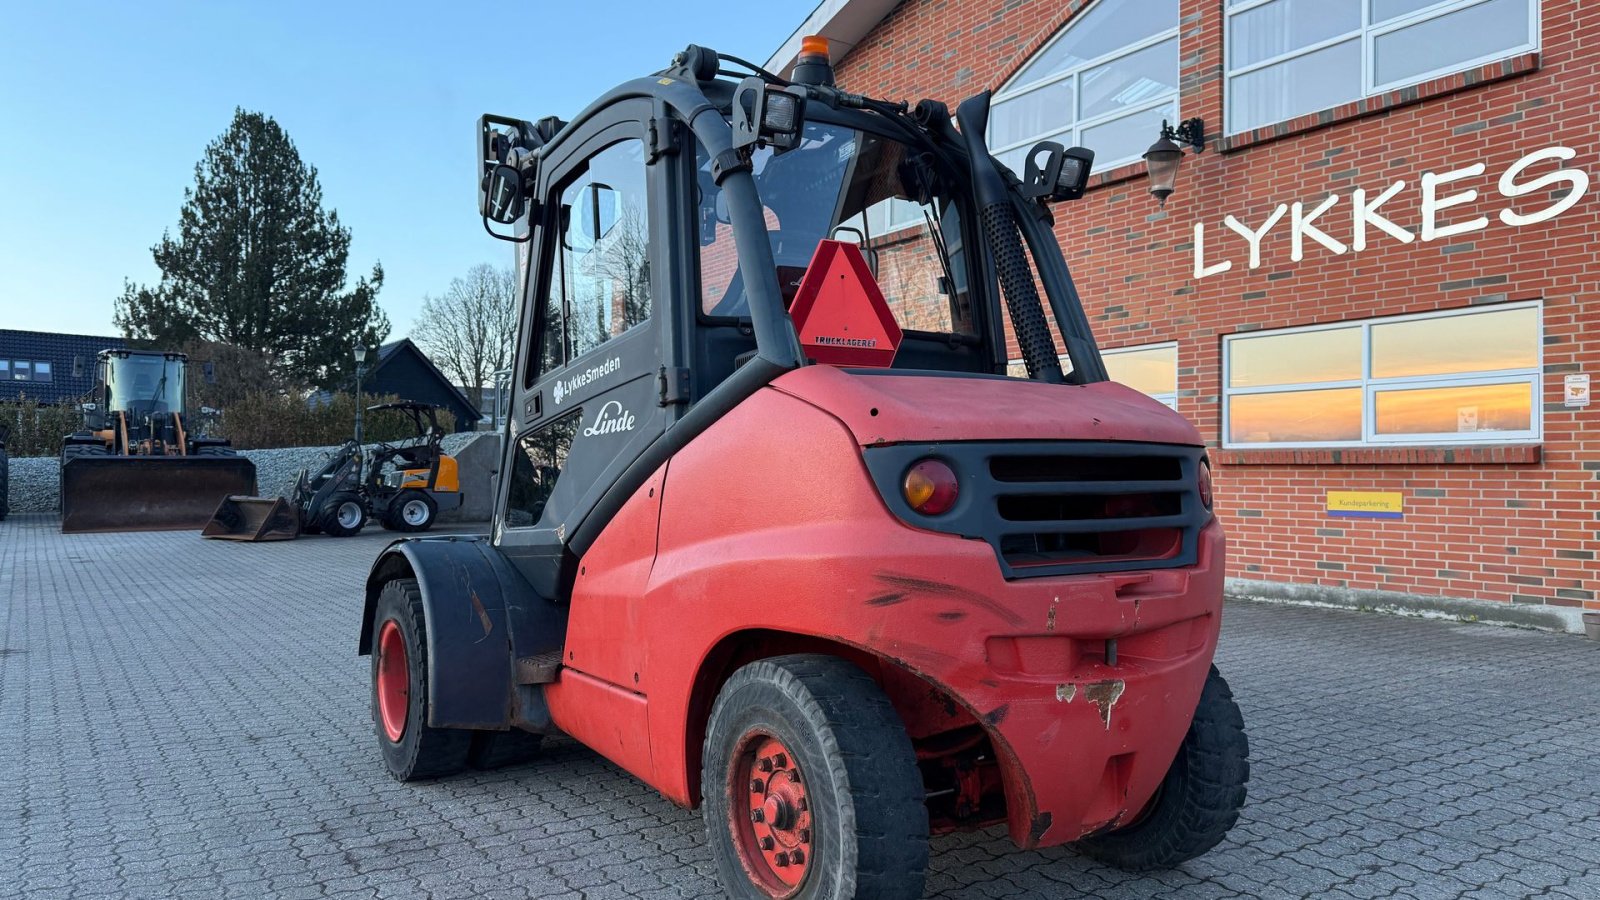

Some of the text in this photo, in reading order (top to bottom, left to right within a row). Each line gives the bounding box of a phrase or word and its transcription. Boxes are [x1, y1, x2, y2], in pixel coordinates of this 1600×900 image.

[1193, 146, 1590, 280] LYKKES
[564, 356, 621, 395] LykkeSmeden
[583, 400, 635, 437] Linde
[1339, 499, 1390, 509] Kundeparkering
